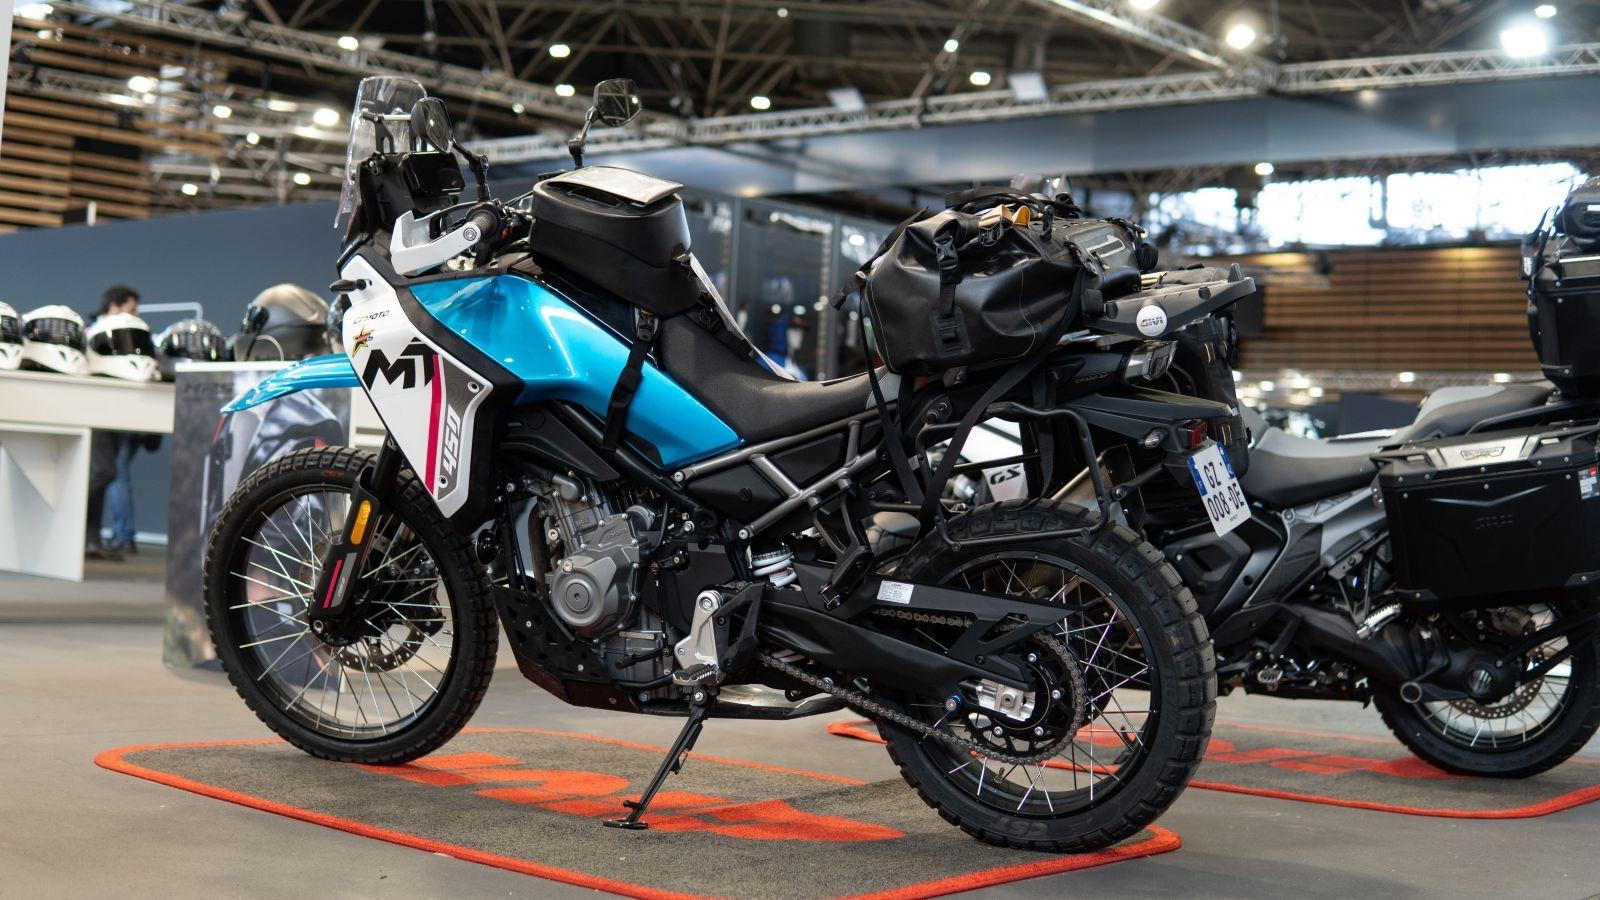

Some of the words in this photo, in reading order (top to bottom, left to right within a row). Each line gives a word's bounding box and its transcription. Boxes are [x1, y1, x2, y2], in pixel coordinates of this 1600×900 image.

[1139, 316, 1164, 328] GIVI
[362, 337, 439, 392] MT
[441, 404, 461, 477] 450
[990, 465, 1020, 485] GS
